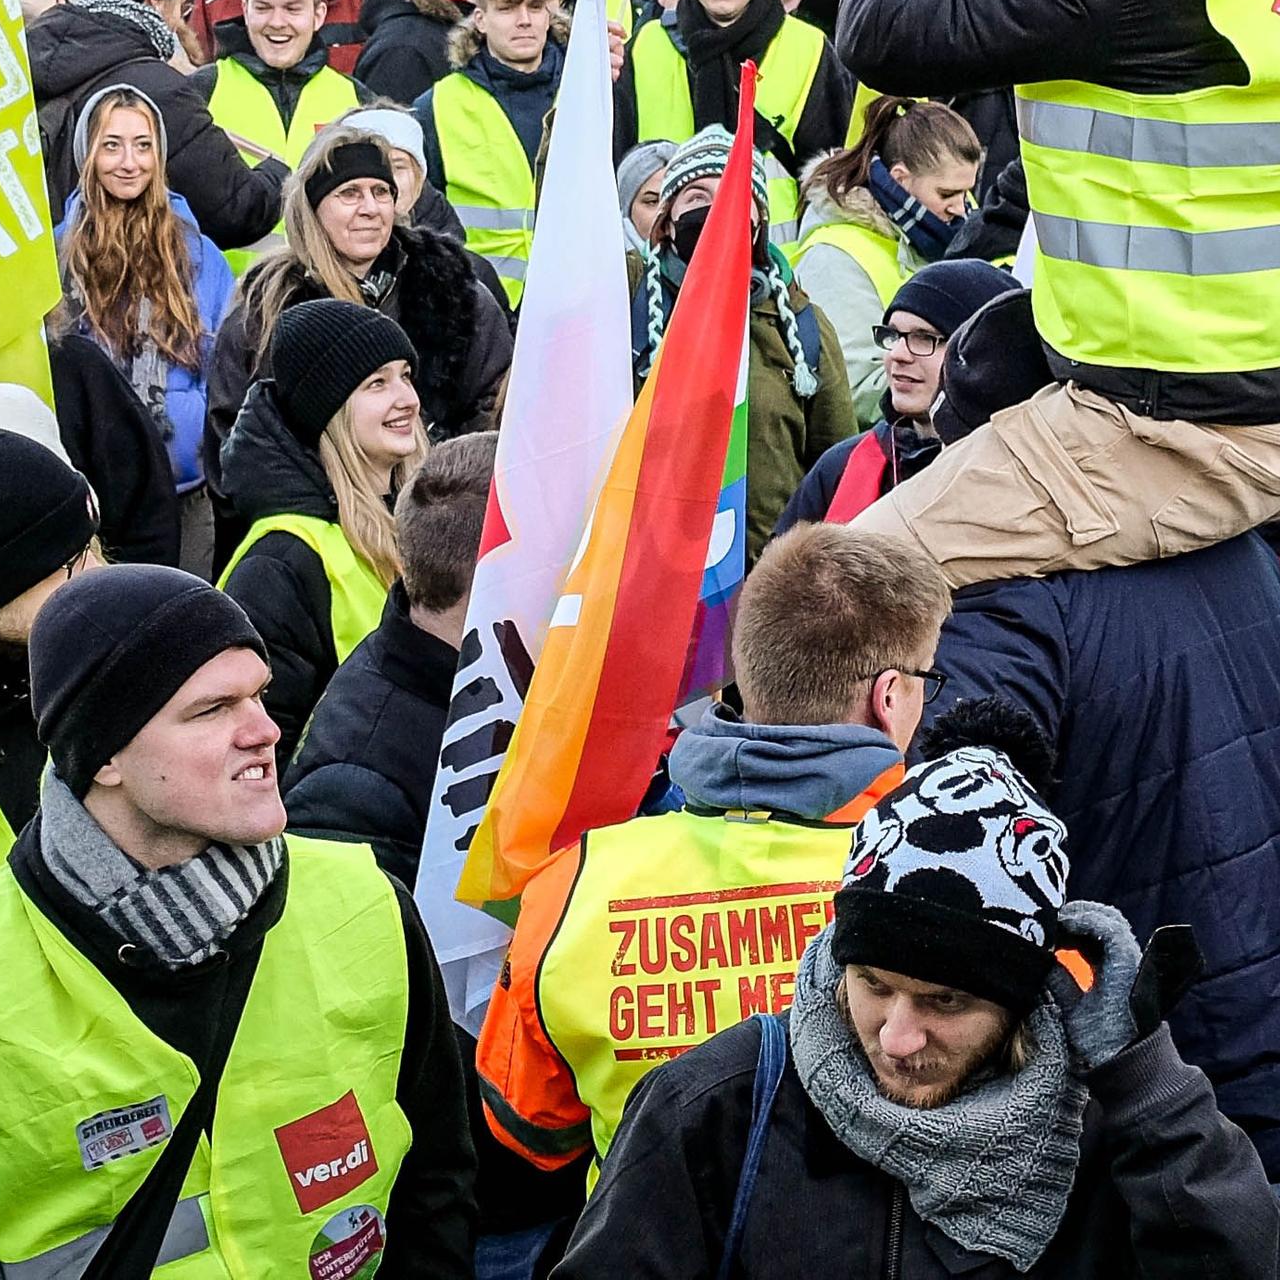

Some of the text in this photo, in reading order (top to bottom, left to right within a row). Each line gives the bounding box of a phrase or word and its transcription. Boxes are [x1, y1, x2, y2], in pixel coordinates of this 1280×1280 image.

[608, 900, 836, 977] ZUSAMME
[609, 978, 721, 1041] GEHT
[294, 1138, 369, 1188] ver.di
